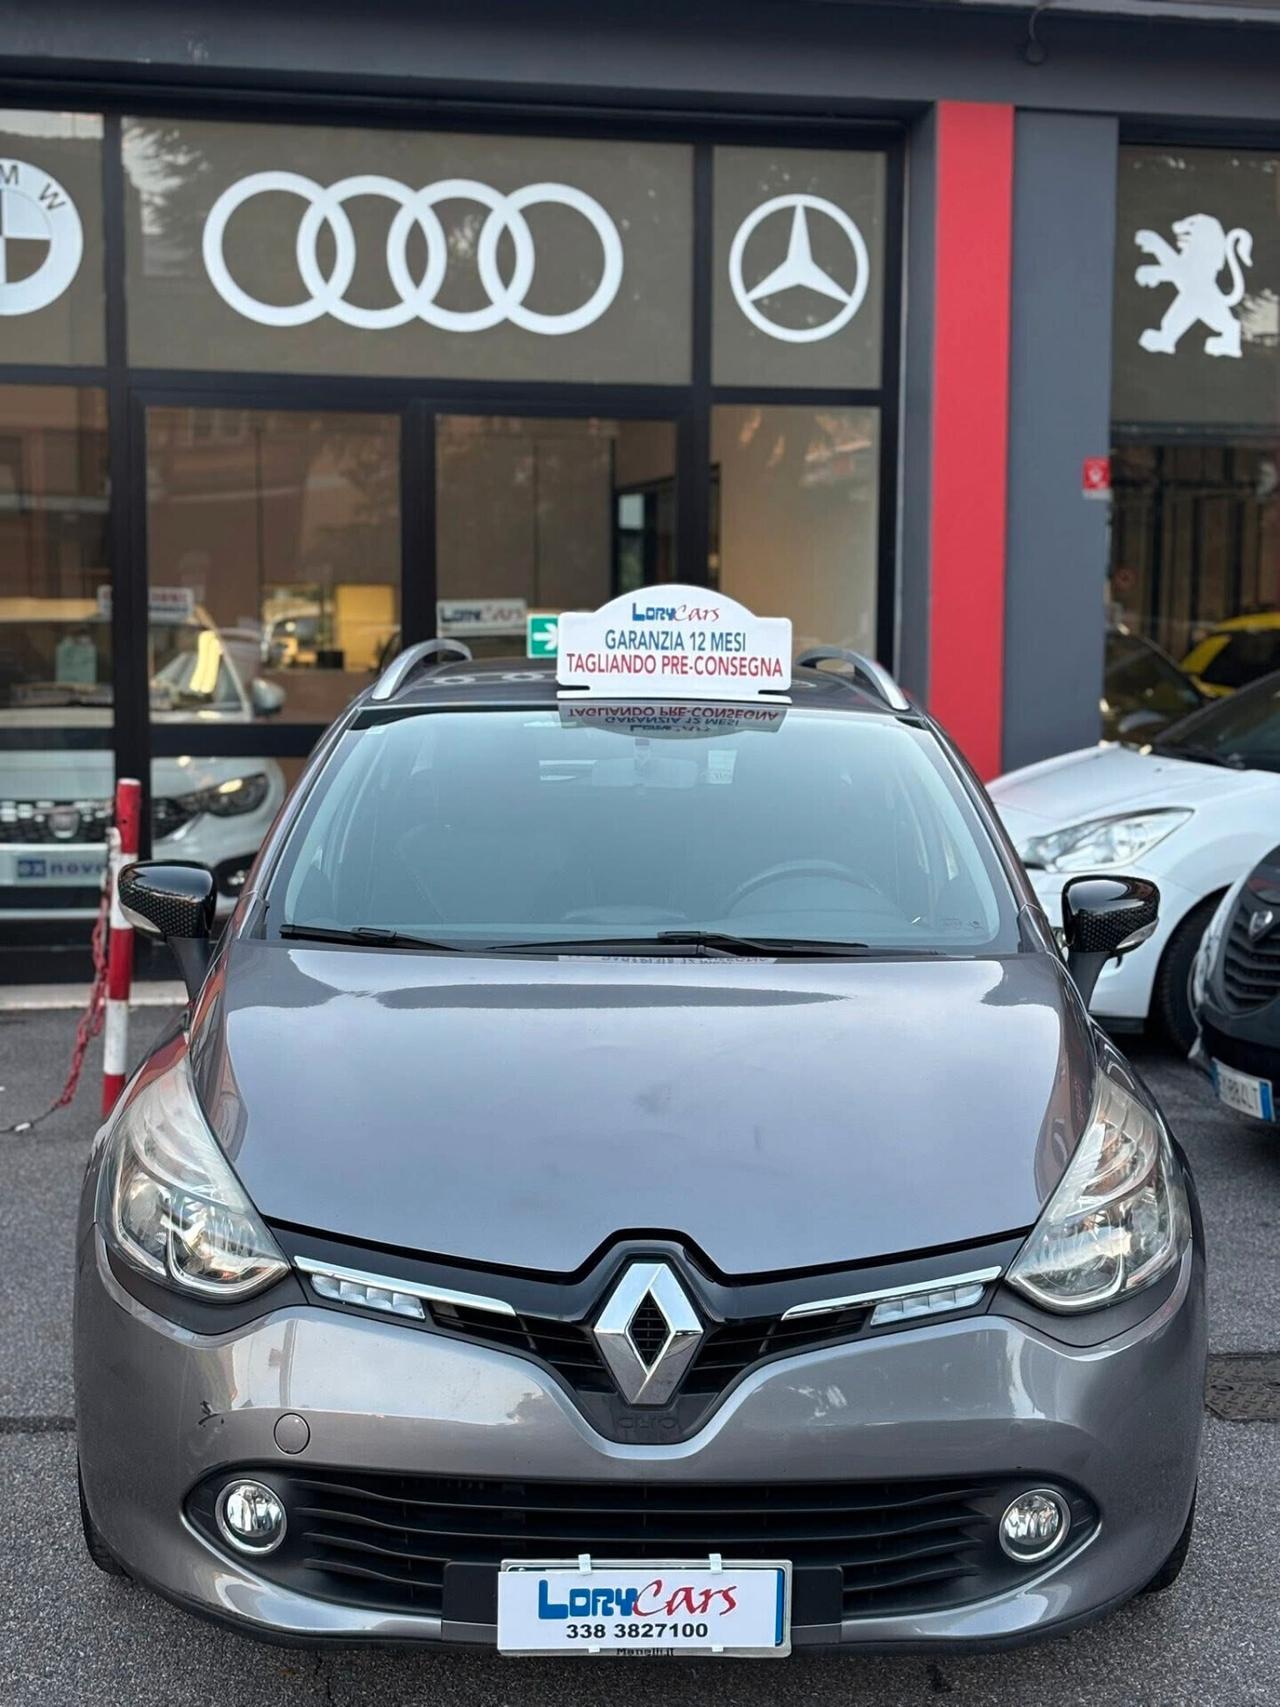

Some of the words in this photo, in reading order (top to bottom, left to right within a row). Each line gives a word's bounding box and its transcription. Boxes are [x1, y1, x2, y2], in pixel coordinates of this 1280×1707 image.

[605, 629, 685, 650] GARANZIA
[689, 631, 706, 651] 12
[710, 632, 746, 652] MESI
[566, 653, 657, 674] TAGLIANDO
[661, 655, 783, 677] PRE-CONSEGNA
[566, 1624, 606, 1639] 338
[614, 1623, 709, 1638] 3827100
